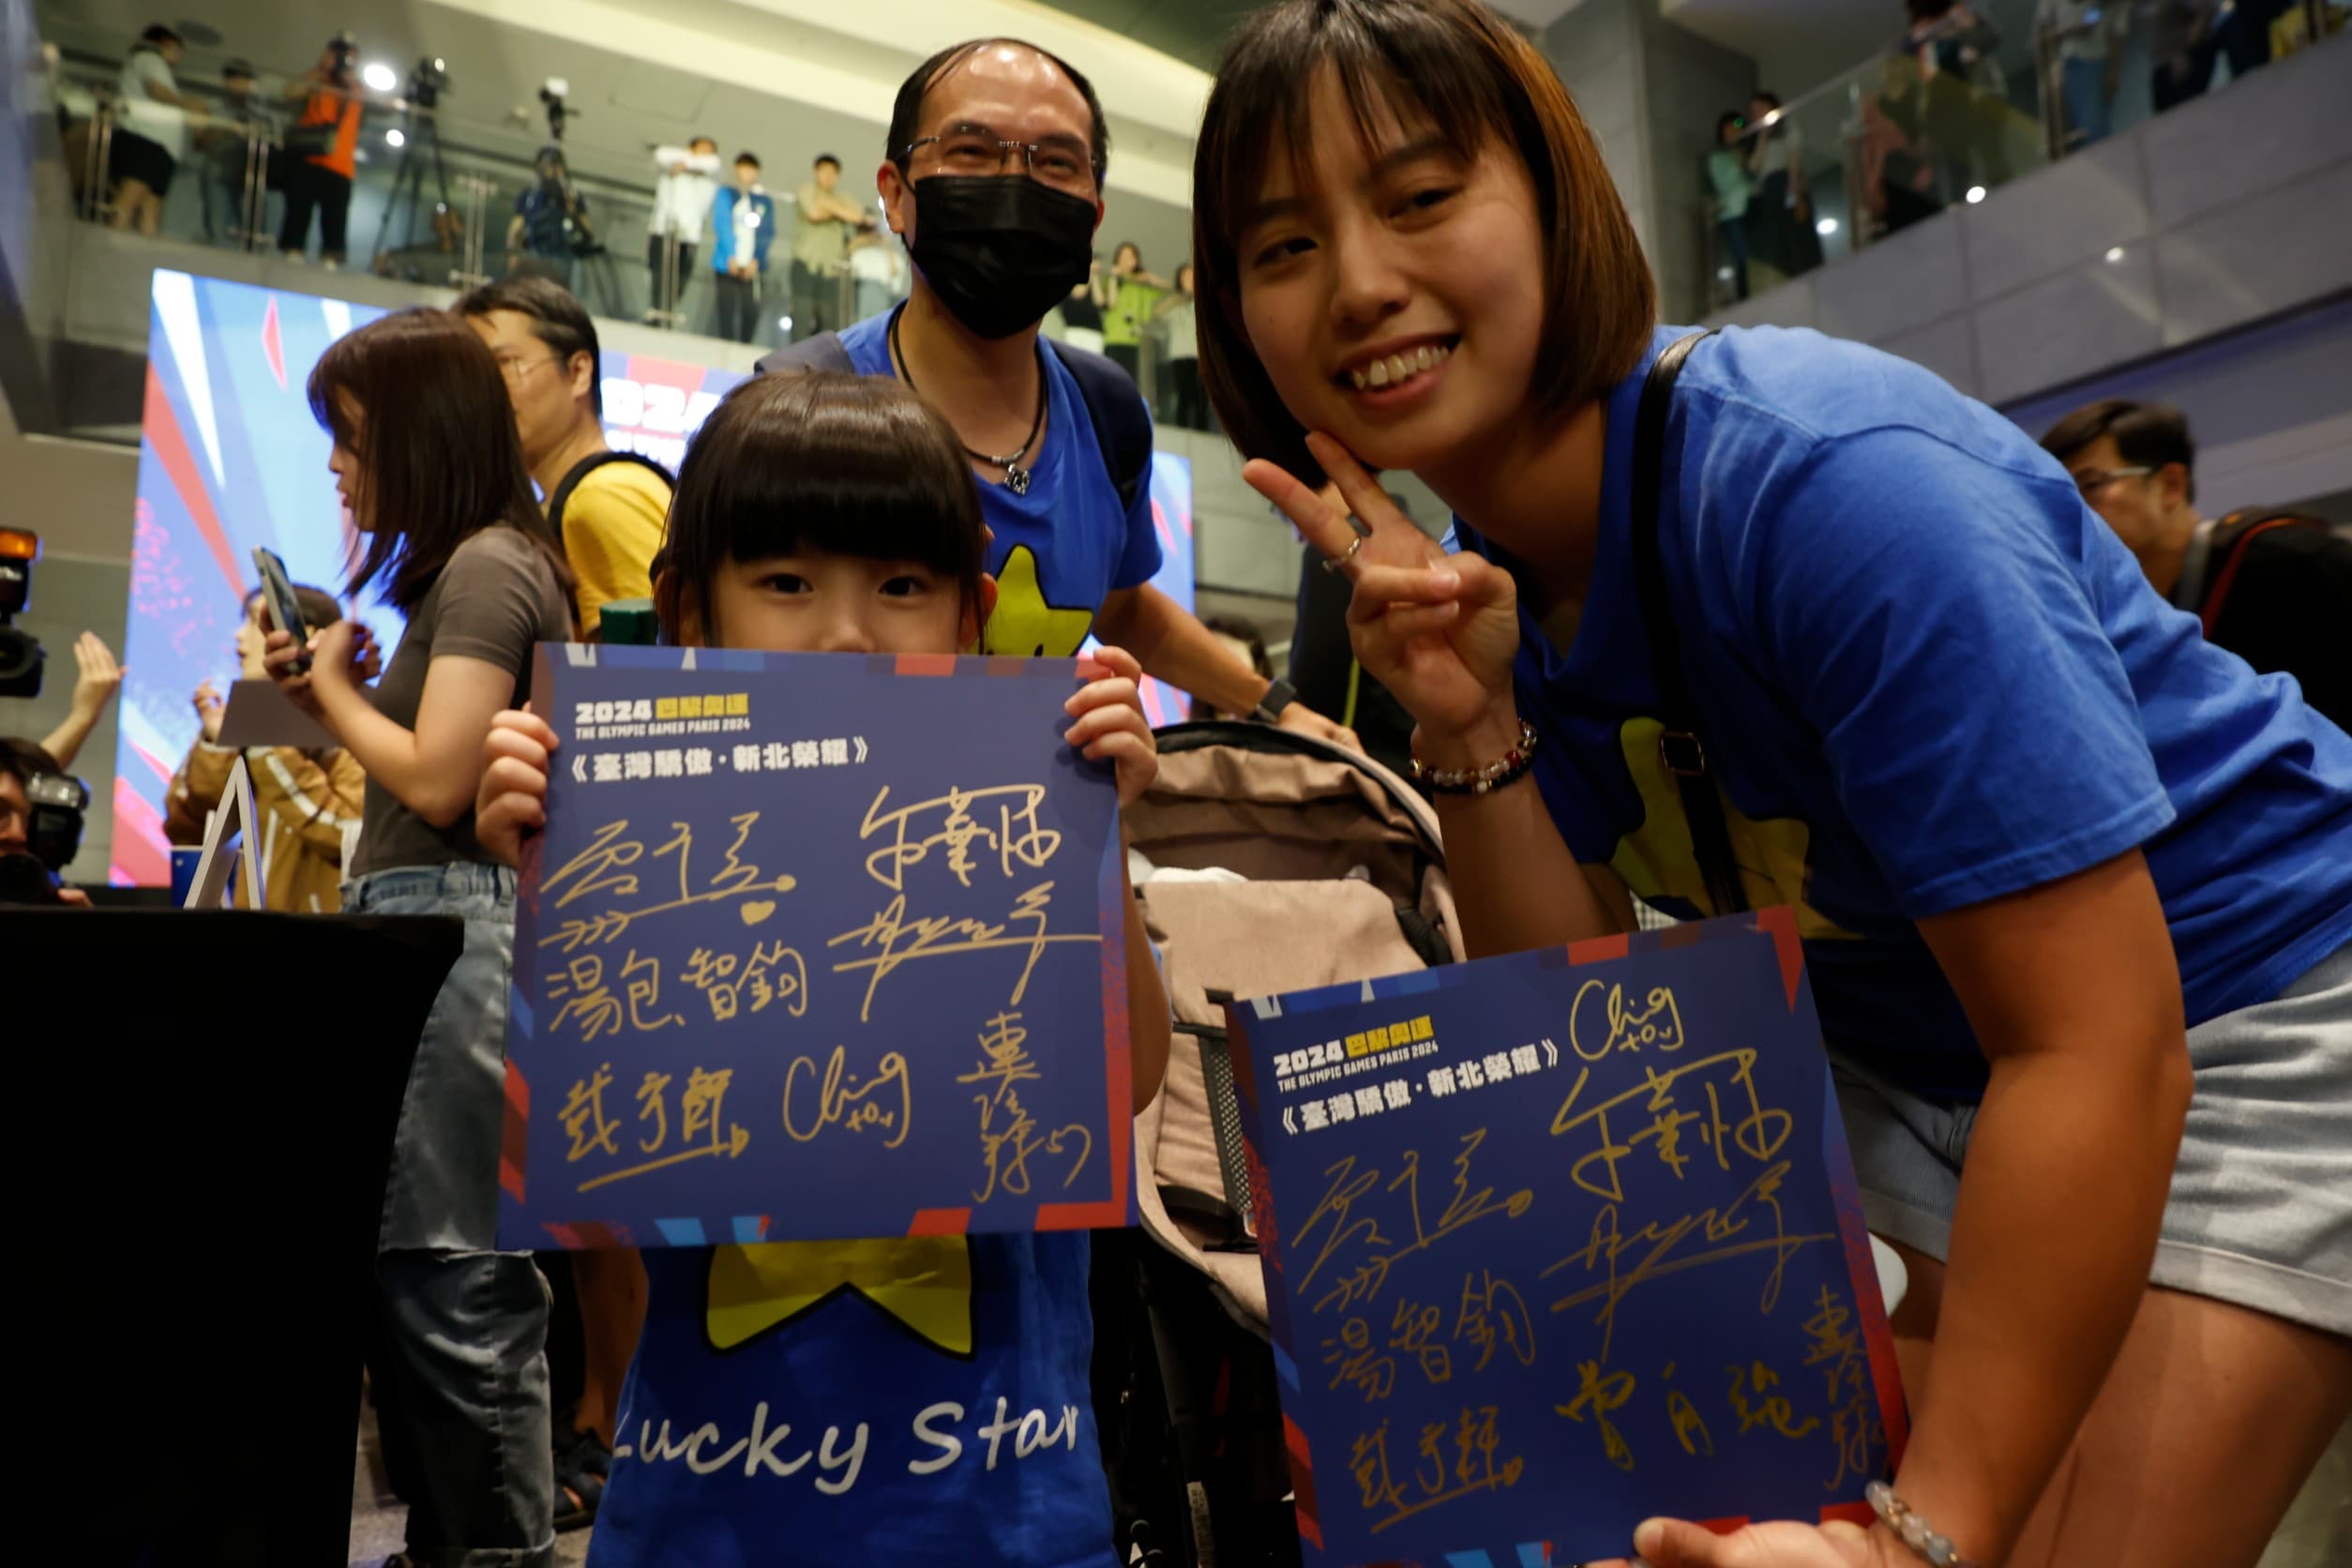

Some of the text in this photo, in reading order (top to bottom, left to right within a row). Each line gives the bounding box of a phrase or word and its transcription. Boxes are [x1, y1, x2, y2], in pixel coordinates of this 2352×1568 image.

[574, 699, 653, 726] 2024
[575, 716, 751, 741] THE OLYMPIC GAMES PARIS 2024
[1274, 1039, 1345, 1078] 2024
[1277, 1039, 1440, 1093] THE OLYMPIC GAMES PARIS 2024
[907, 1395, 1079, 1475] Star
